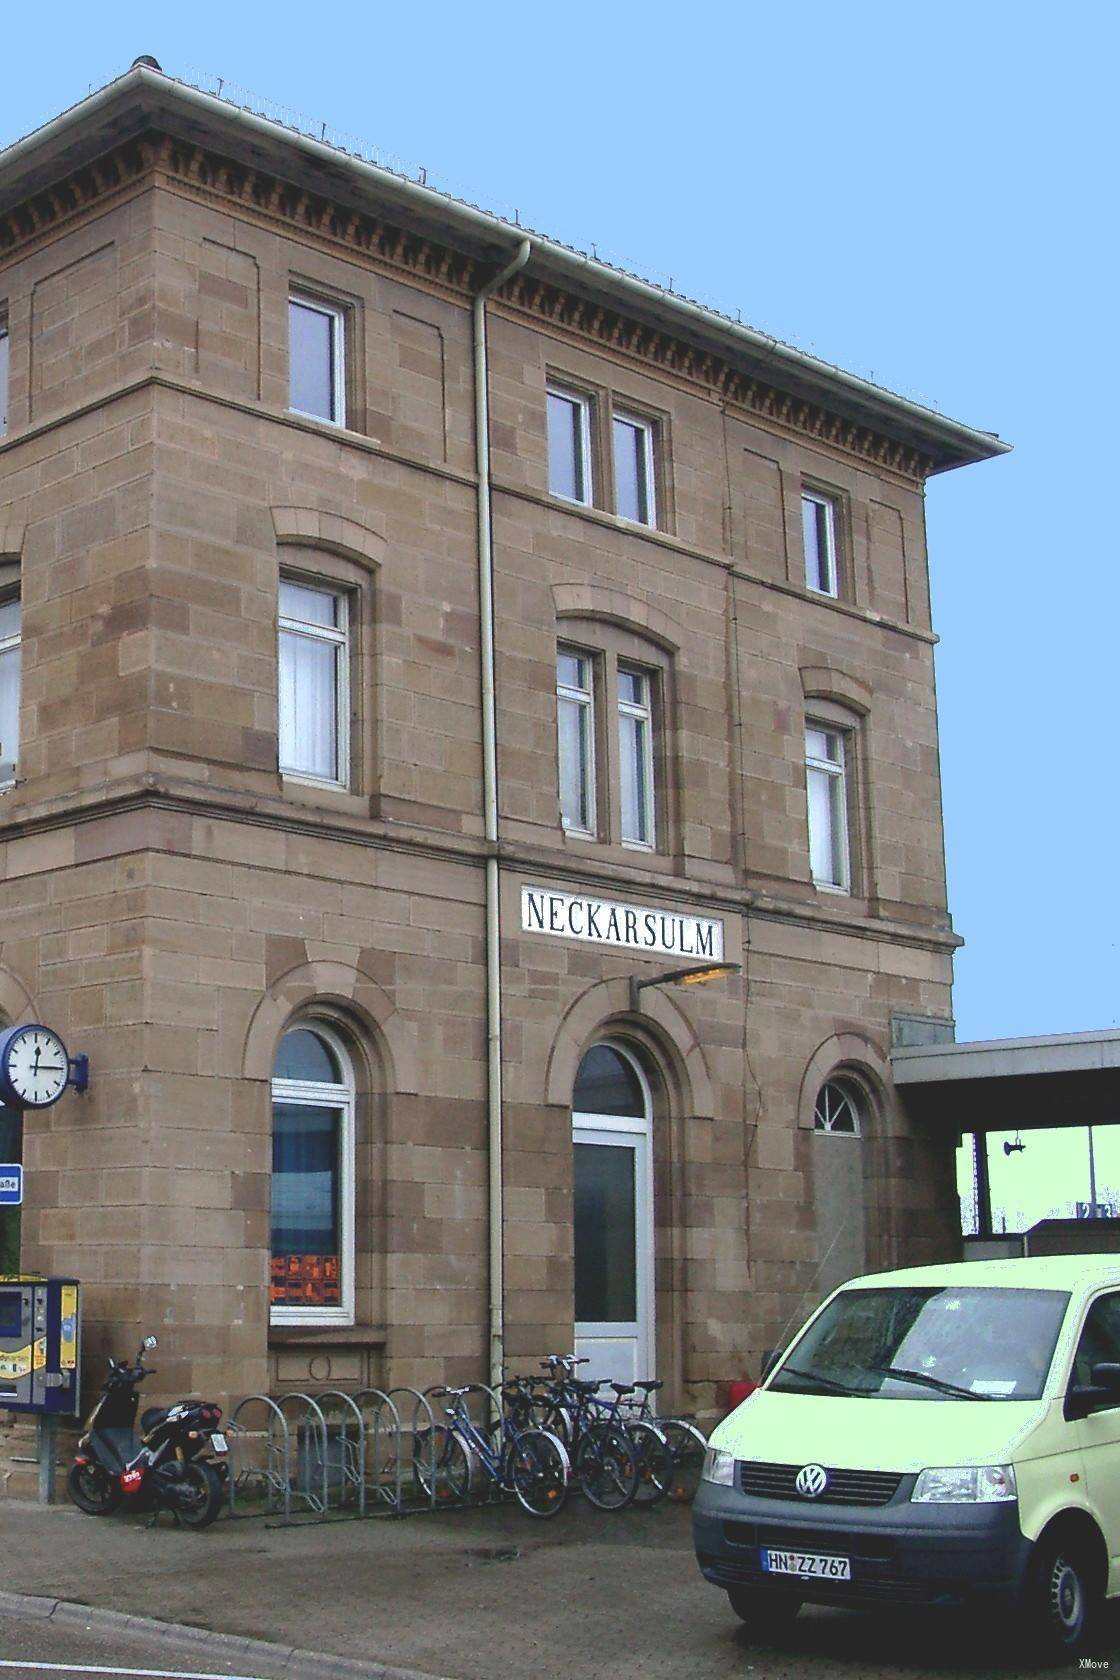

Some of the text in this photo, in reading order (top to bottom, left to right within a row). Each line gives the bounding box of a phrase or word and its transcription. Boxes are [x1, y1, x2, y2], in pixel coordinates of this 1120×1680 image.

[527, 893, 714, 957] NECKARSULM
[769, 1553, 848, 1577] HN ZZ 767
